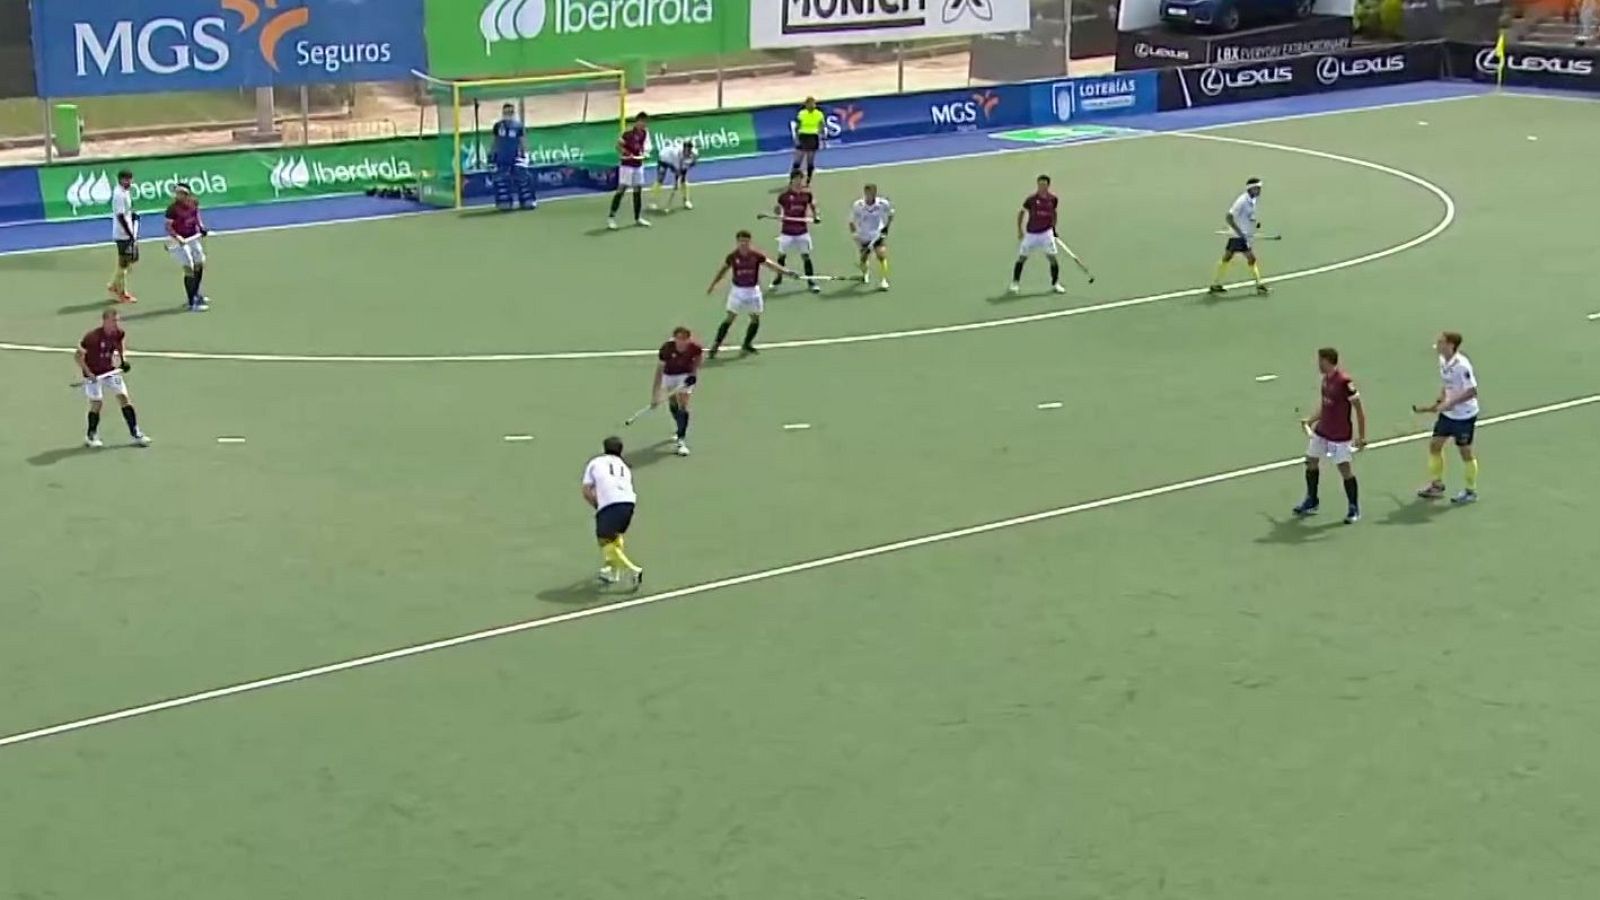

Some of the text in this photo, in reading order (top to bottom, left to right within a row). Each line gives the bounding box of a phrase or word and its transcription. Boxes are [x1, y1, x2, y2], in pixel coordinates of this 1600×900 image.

[555, 0, 713, 33] Iberdrola
[73, 16, 230, 77] MGS
[296, 40, 391, 72] Seguros
[1341, 55, 1405, 76] LEXUS
[1507, 55, 1592, 75] LEXUS
[1080, 78, 1137, 97] LOTERÍAS
[1225, 67, 1293, 88] LEXUS
[932, 102, 976, 125] MGS
[313, 156, 412, 185] Iberdrola
[113, 170, 227, 200] berdola
[609, 463, 624, 477] 11
